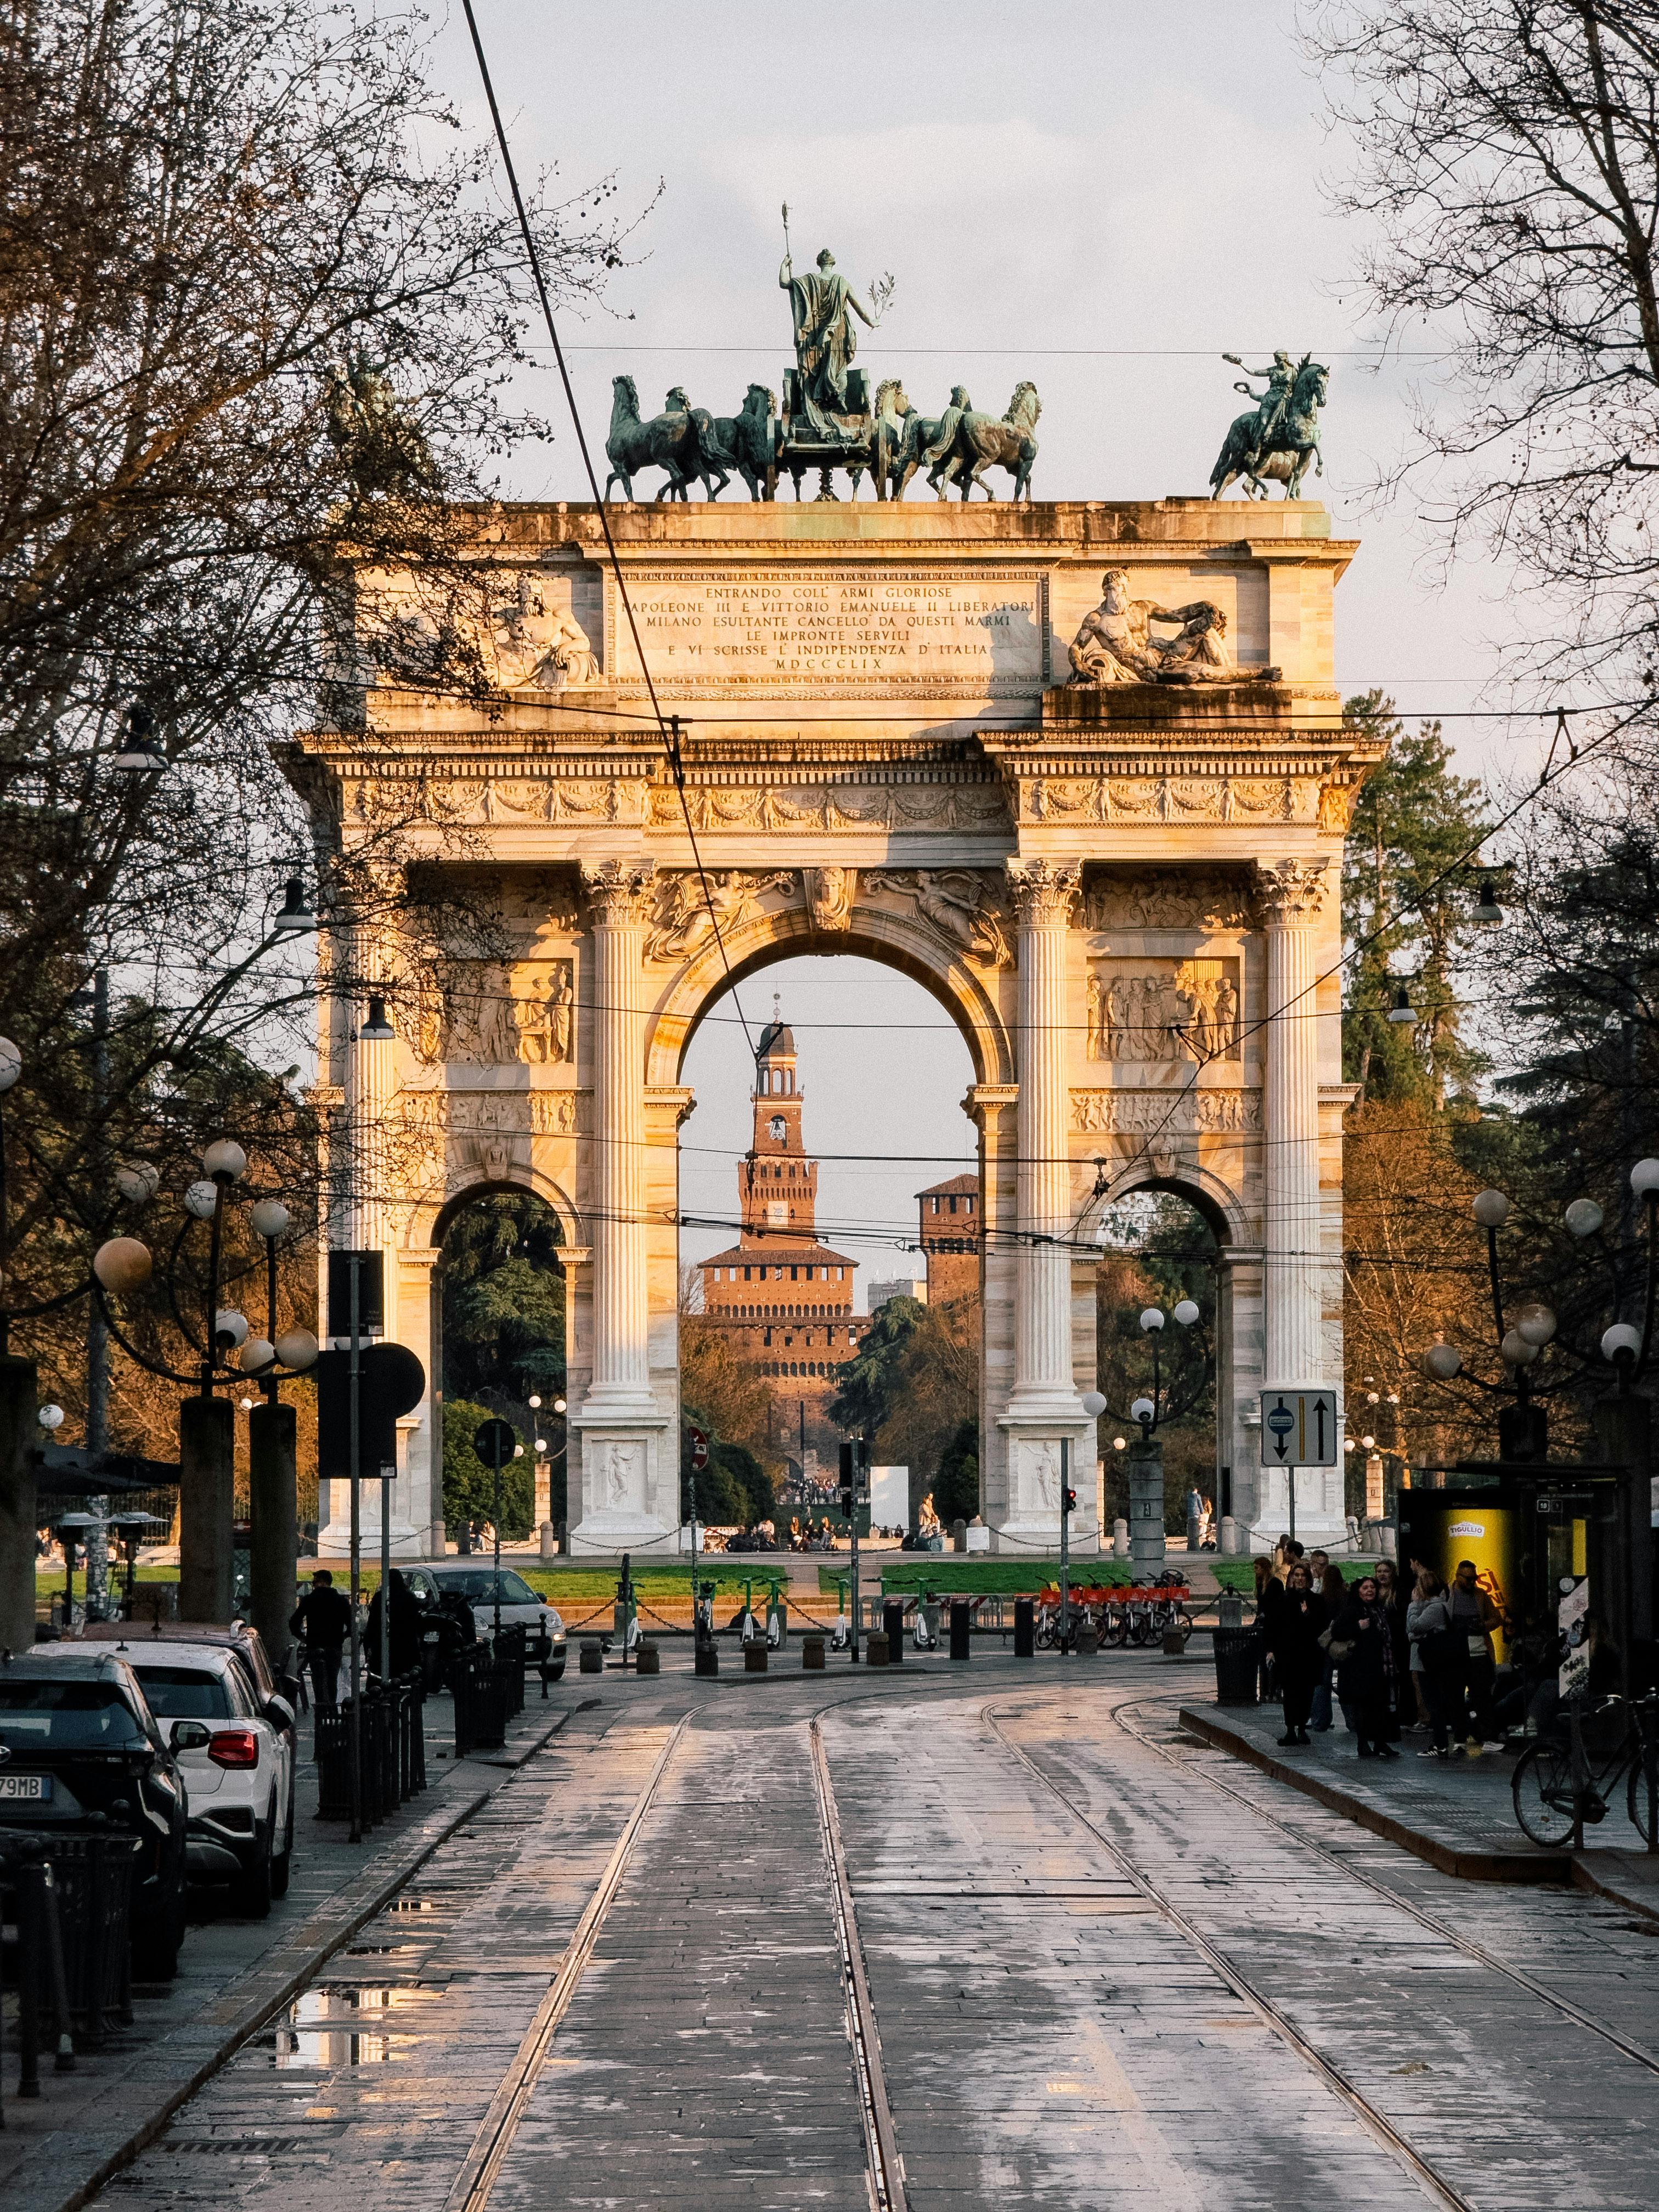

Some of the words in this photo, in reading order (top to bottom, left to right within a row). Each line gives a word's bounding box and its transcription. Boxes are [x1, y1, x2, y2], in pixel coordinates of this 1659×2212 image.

[706, 588, 781, 599] ENTRANDO
[840, 588, 873, 597] ARMI
[885, 588, 952, 597] GLORIOSE
[716, 603, 730, 612] III
[742, 603, 749, 612] E
[762, 602, 829, 612] VITTORIO
[840, 602, 916, 612] EMANUELE
[928, 602, 936, 612] II
[949, 602, 1034, 611] LIBERATORI
[647, 617, 701, 627] MILANO
[714, 617, 788, 627] ESULTANTE
[879, 617, 895, 626] DA
[906, 617, 955, 627] QUESTI
[965, 616, 1010, 625] MARMI
[747, 631, 761, 641] LE
[773, 631, 845, 641] IMPRONTE
[857, 631, 909, 640] SERVILI
[669, 646, 675, 655] E
[689, 645, 702, 654] VI
[714, 646, 767, 655] SCRISSE
[798, 645, 906, 654] INDIPENDENZA
[939, 645, 987, 654] ITALIA
